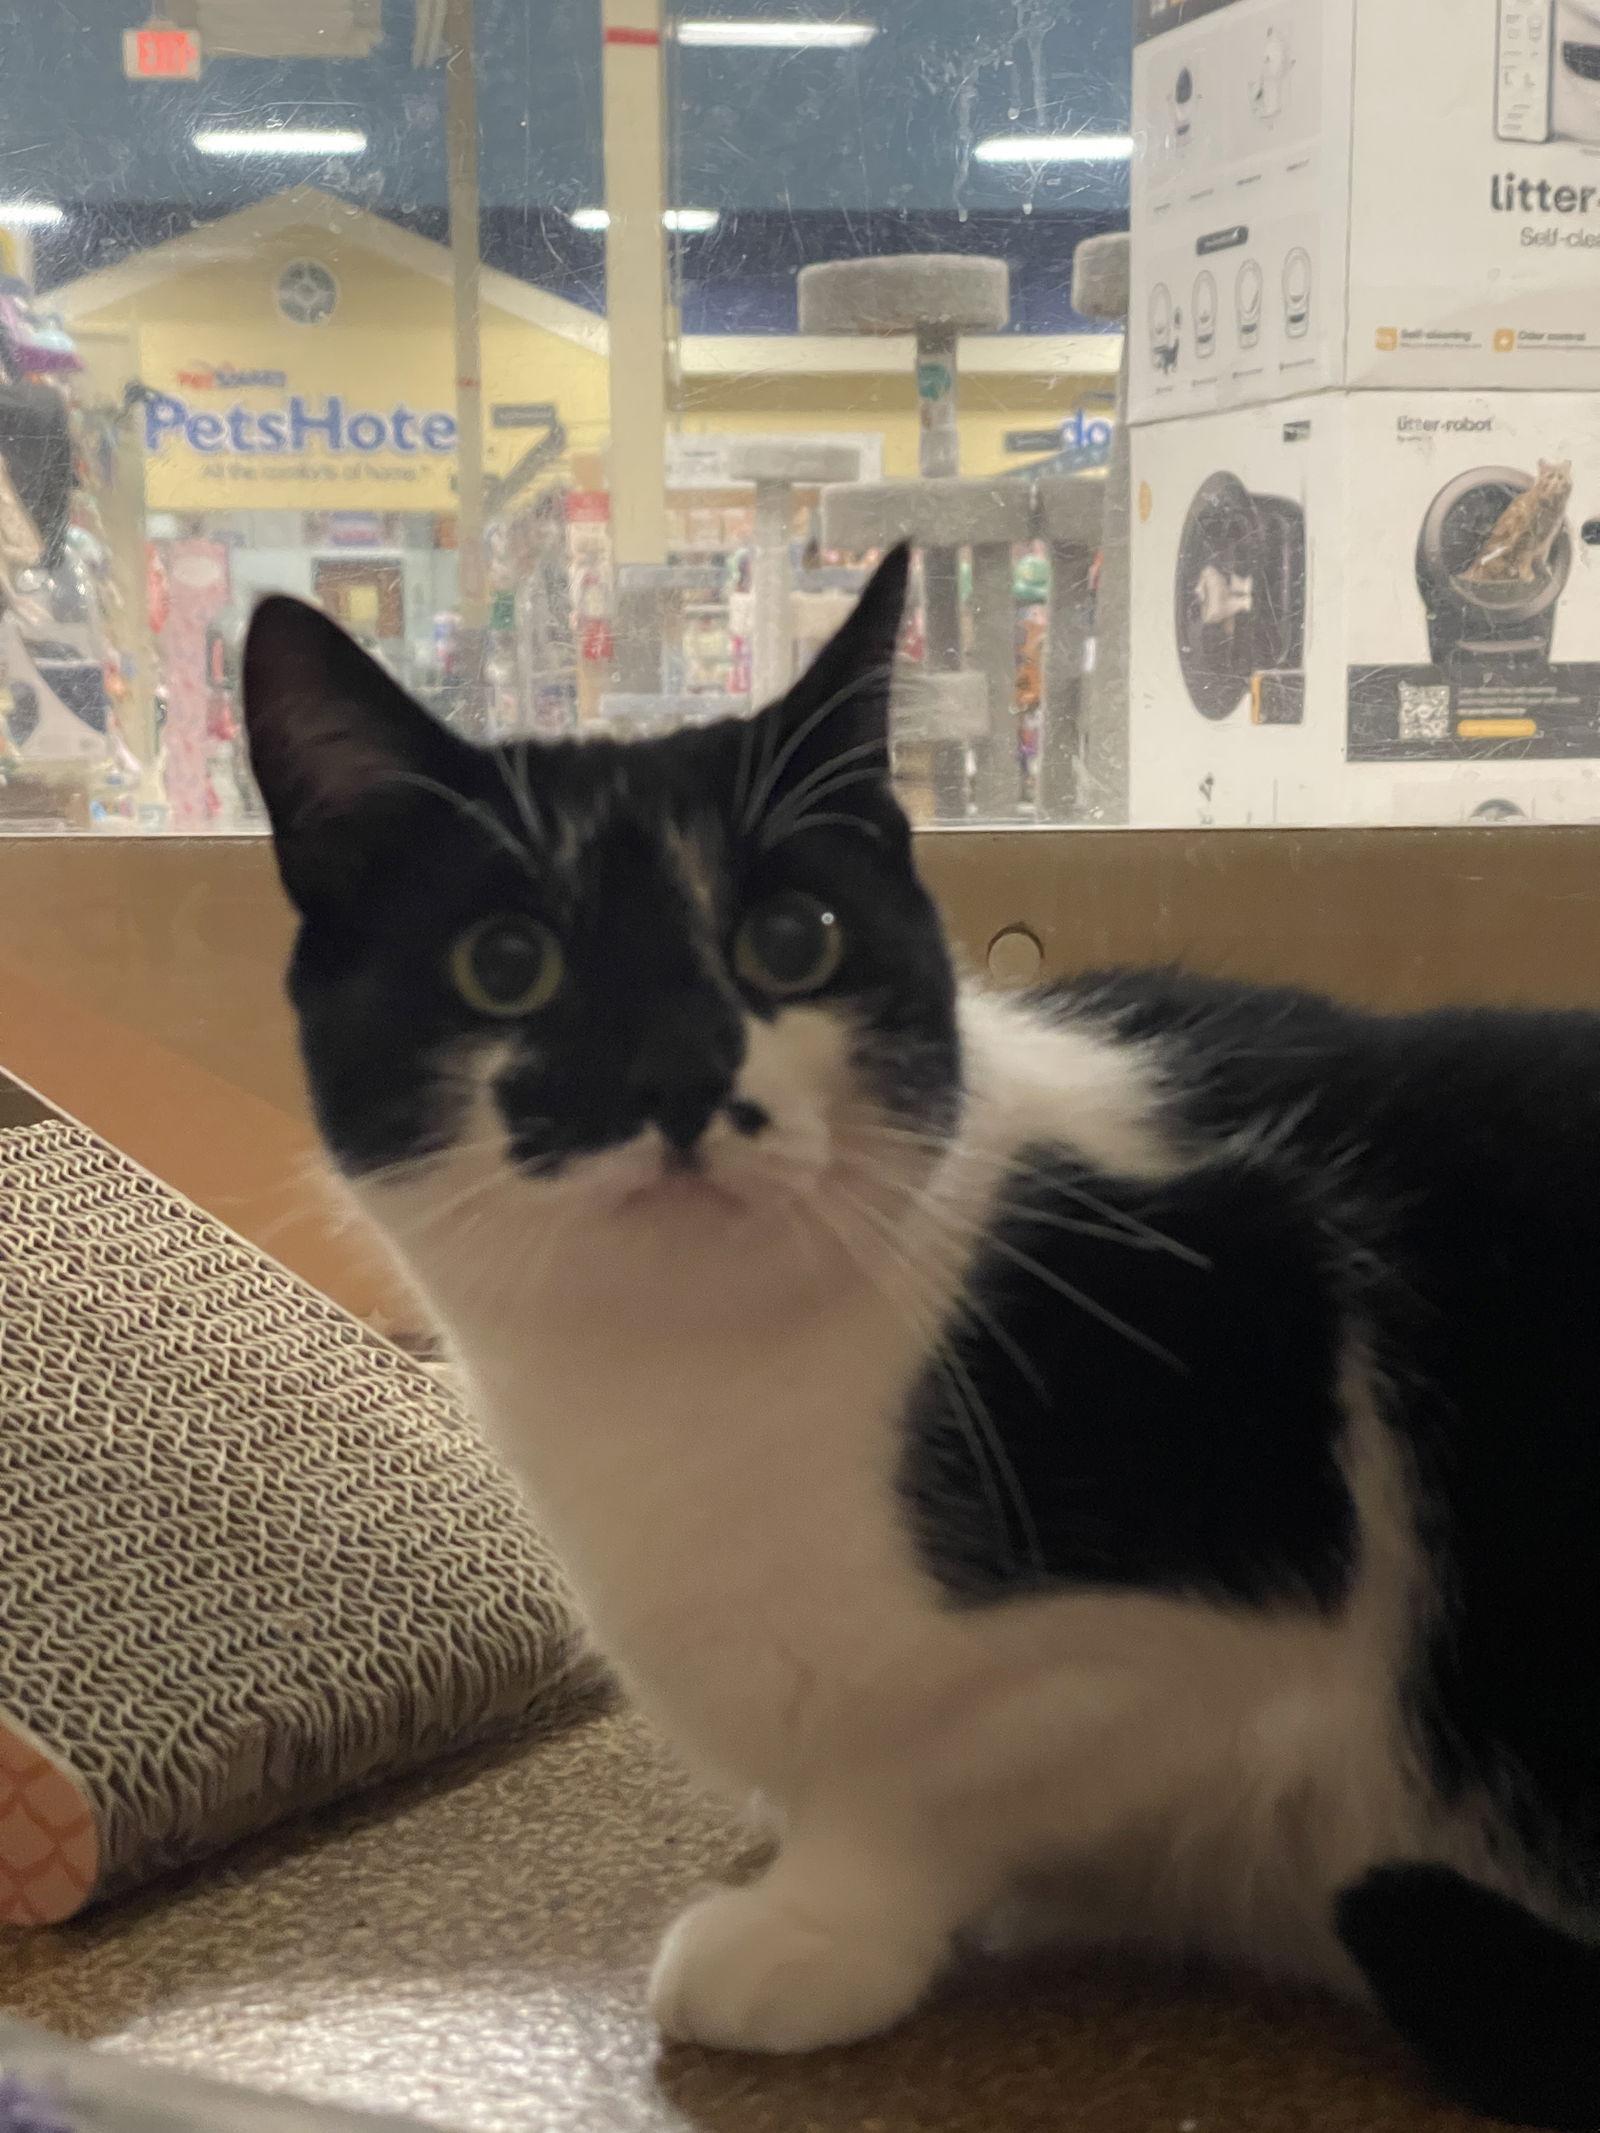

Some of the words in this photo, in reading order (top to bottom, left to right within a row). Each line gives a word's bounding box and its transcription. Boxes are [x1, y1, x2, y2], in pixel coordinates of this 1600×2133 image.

[1490, 171, 1600, 213] litter
[143, 395, 458, 452] PetsHote
[1058, 408, 1111, 449] do
